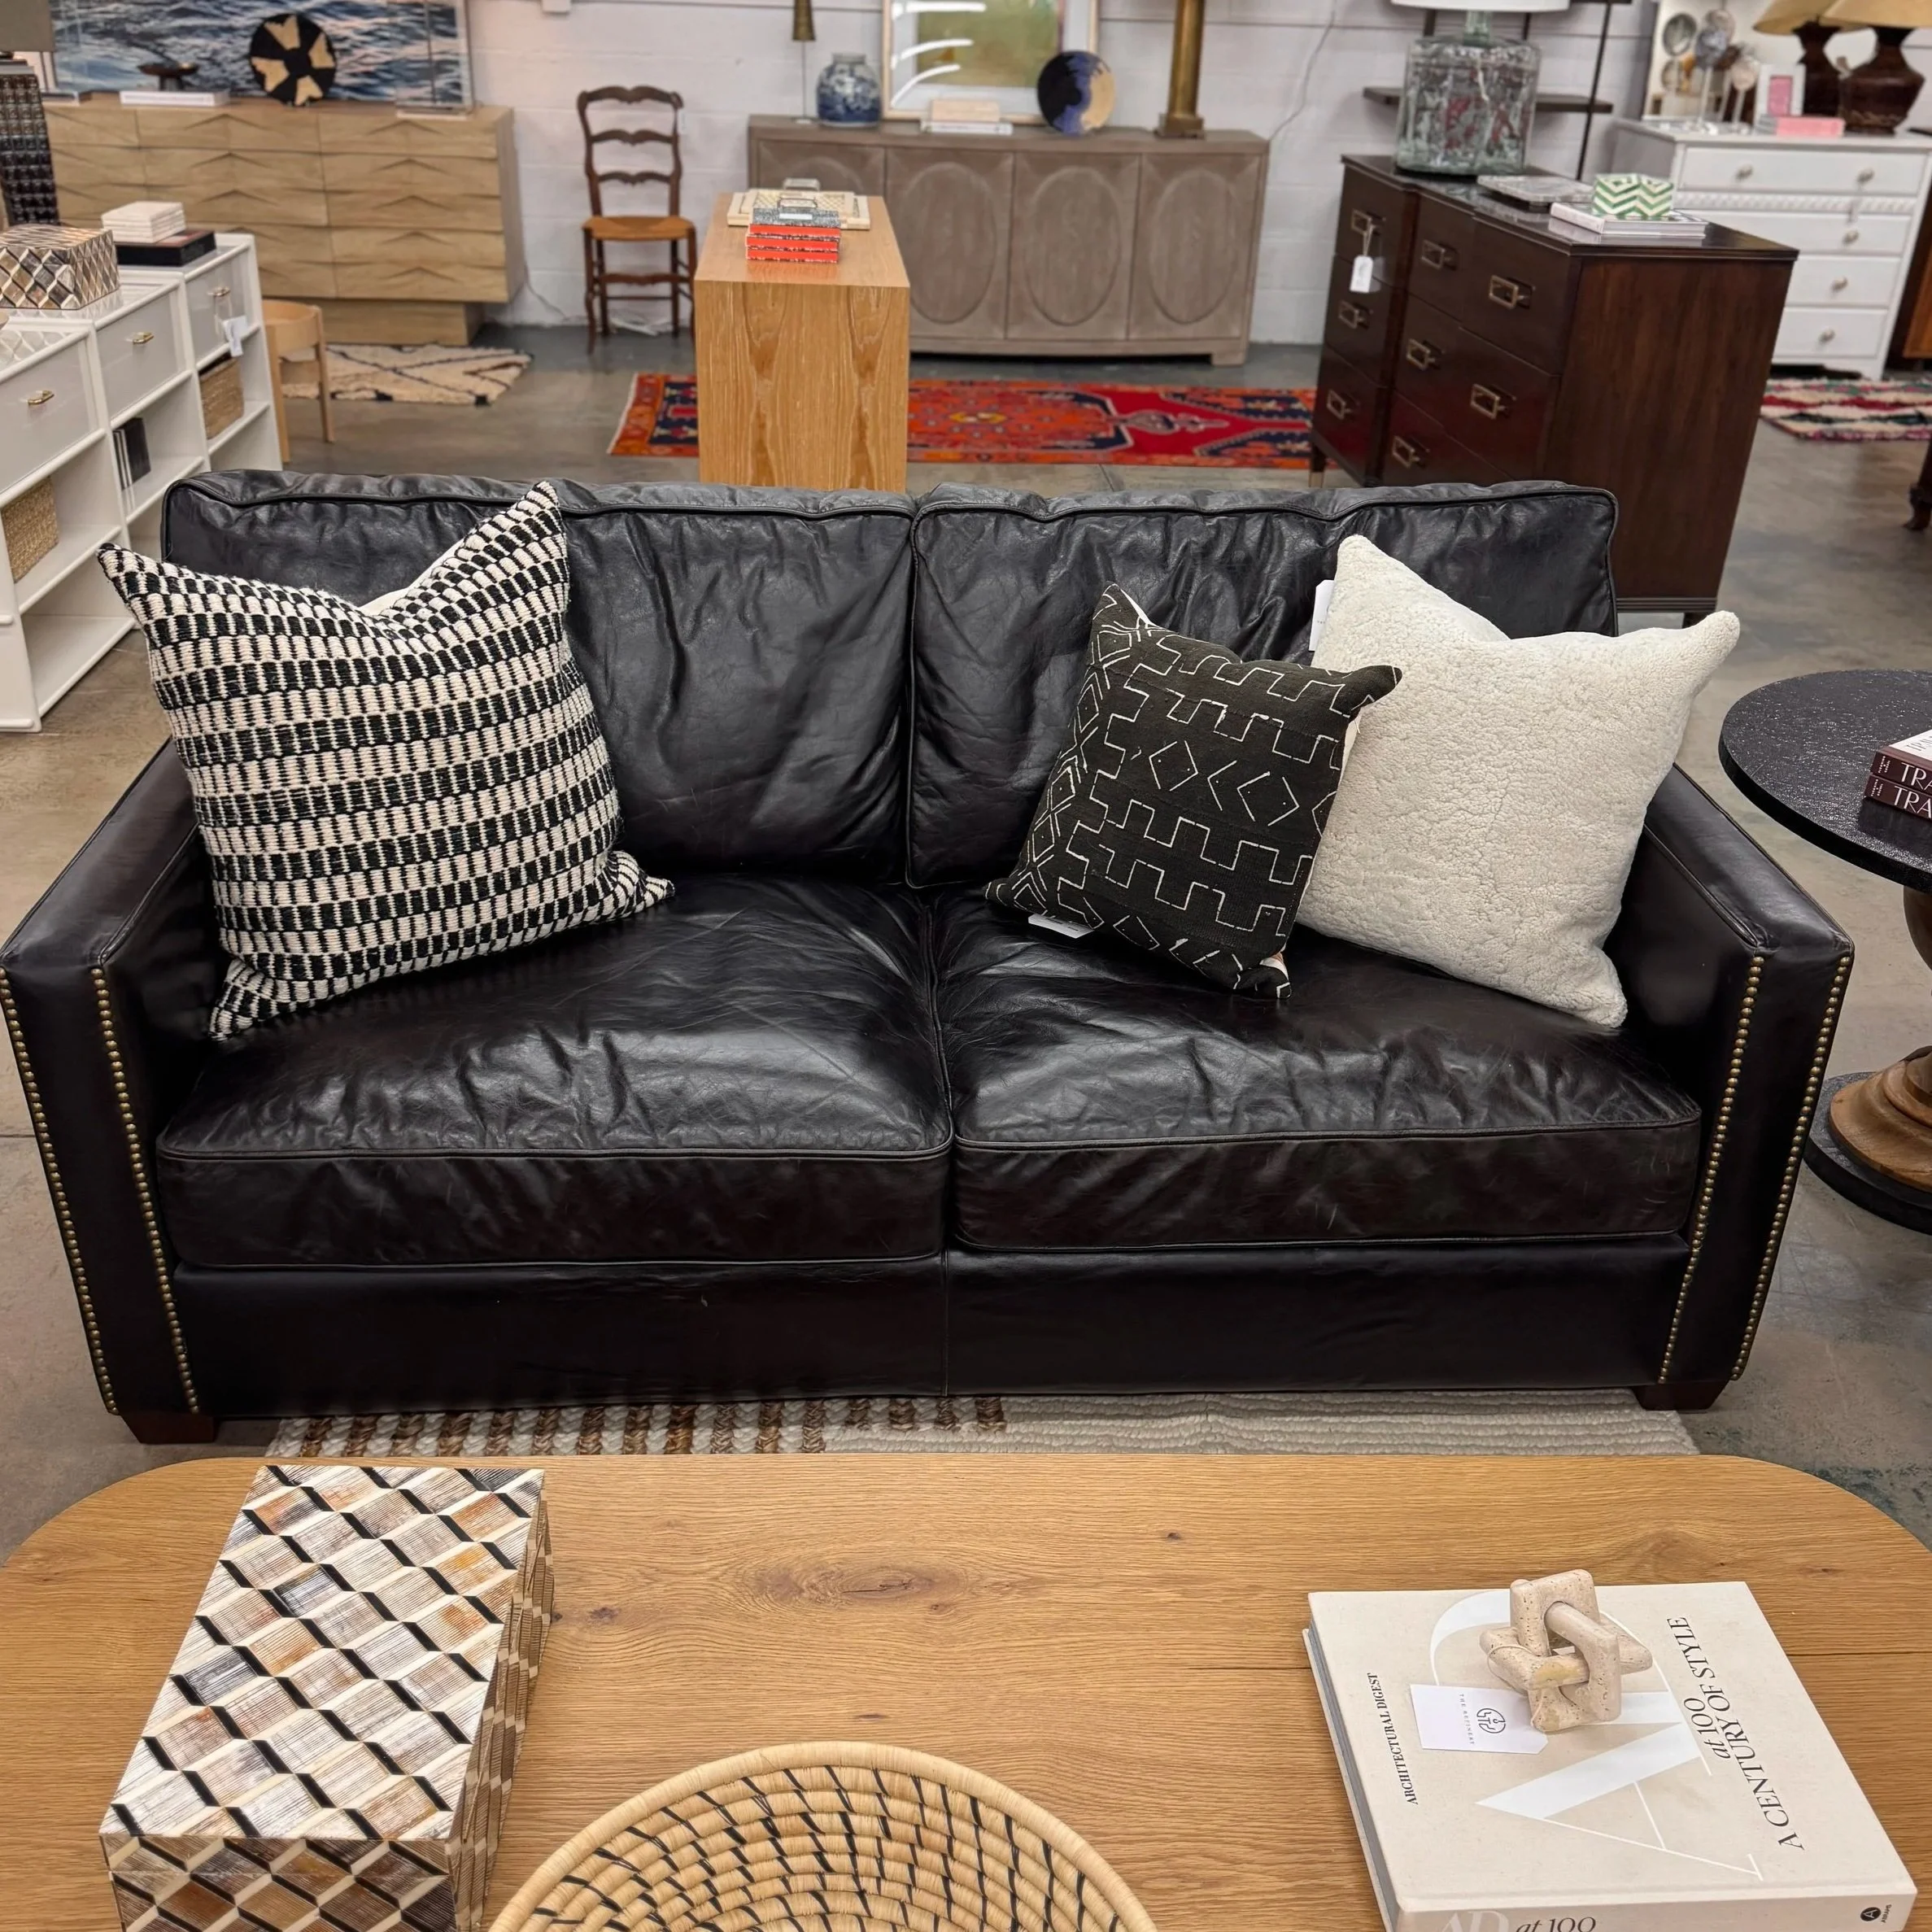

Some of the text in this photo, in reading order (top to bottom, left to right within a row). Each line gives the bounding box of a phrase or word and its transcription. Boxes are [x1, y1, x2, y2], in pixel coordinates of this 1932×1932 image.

[1367, 1673, 1419, 1805] ARCHITECTURAL DIGEST
[1667, 1616, 1805, 1851] A CENTURY OF STYLE
[1683, 1697, 1731, 1760] at 100
[1516, 1919, 1543, 1932] at
[1549, 1917, 1597, 1932] 100
